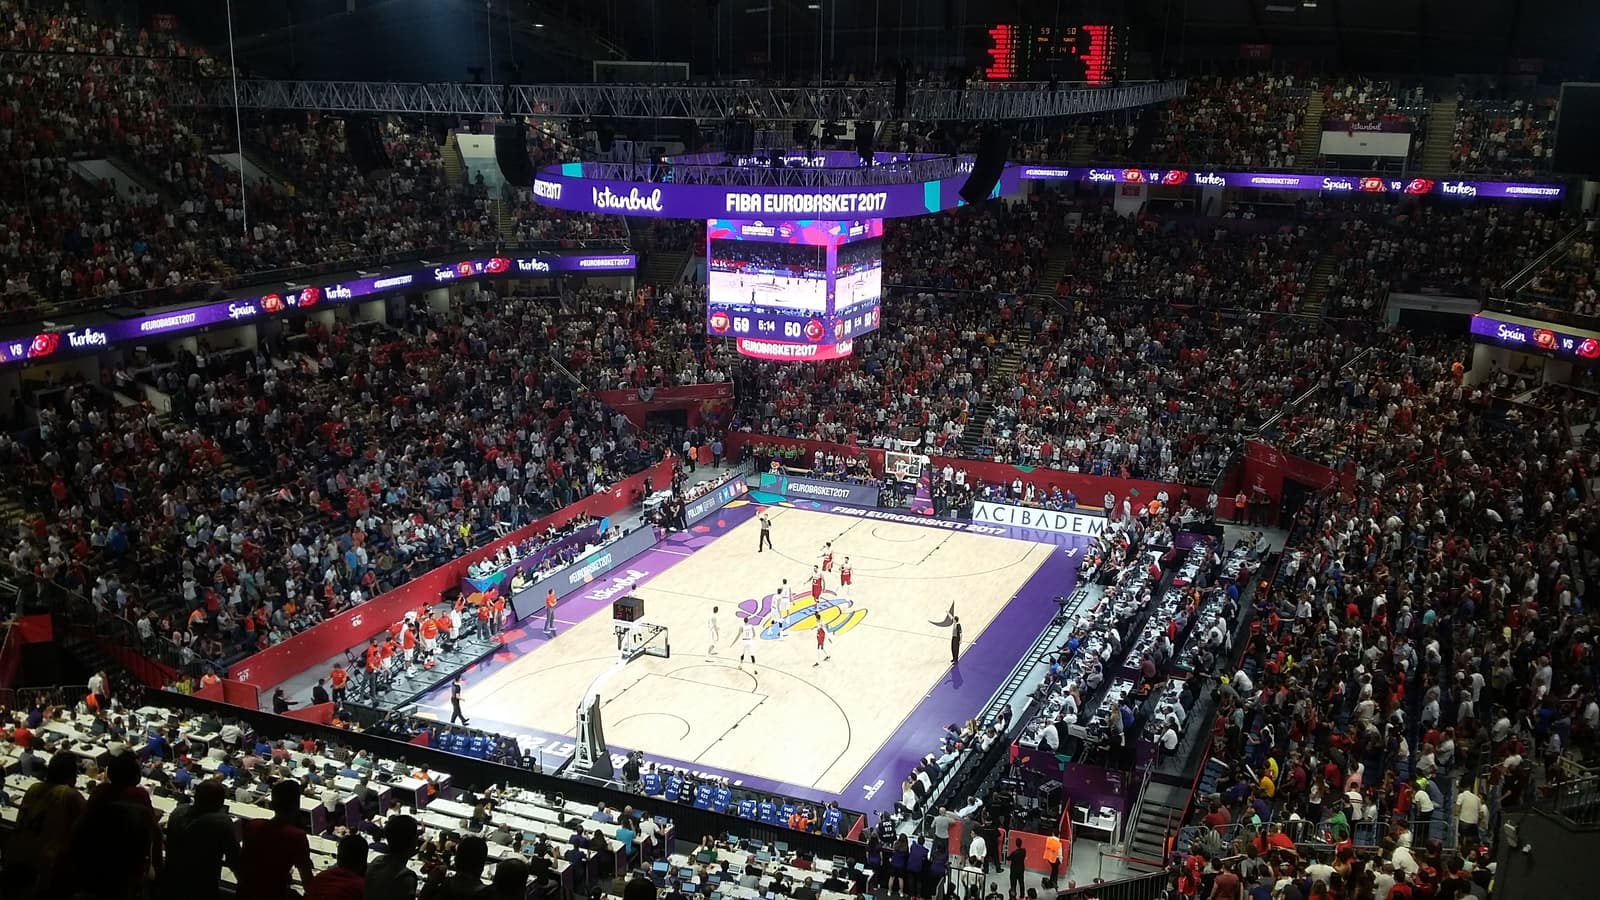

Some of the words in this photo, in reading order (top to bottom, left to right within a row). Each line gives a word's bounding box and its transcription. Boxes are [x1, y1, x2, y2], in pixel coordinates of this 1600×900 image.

[1089, 169, 1116, 181] Spain
[1194, 172, 1225, 186] Turkey
[1322, 177, 1353, 191] Spain
[1442, 181, 1477, 196] Turkey
[592, 186, 663, 212] Istanbul
[726, 193, 761, 212] FIBA
[435, 267, 454, 282] Spain
[517, 258, 549, 272] Turkey
[228, 301, 256, 320] Spain
[325, 284, 351, 299] Turkey
[140, 313, 196, 332] #EUROBASKET2017
[67, 327, 107, 348] Turkey
[1497, 323, 1527, 343] Spain
[741, 339, 818, 356] #EUROBASKET2017
[788, 483, 850, 498] #EUROBASKET2017
[831, 506, 868, 516] FIBA
[964, 523, 1007, 535] 2017
[975, 505, 1104, 534] ACIBADEM
